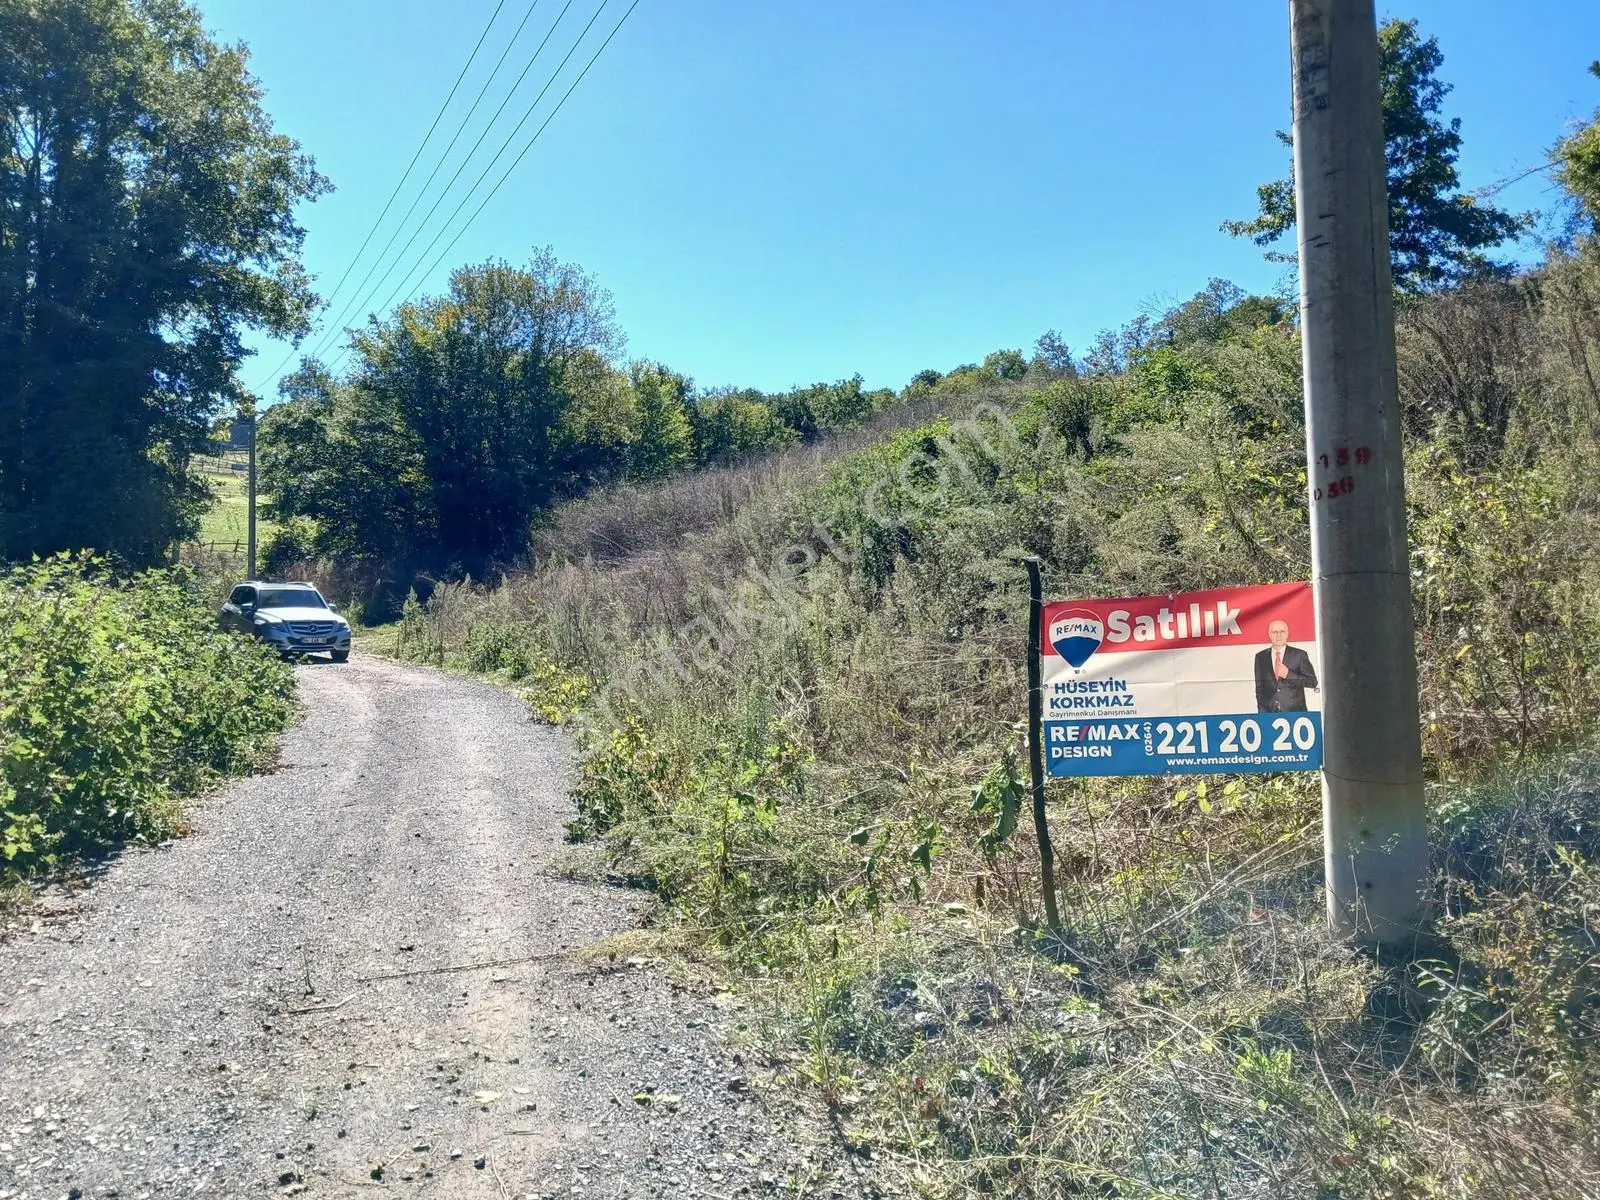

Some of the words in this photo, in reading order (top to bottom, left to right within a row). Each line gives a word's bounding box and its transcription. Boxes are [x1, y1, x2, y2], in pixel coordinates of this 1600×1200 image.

[1056, 623, 1097, 636] RE/MAX
[1106, 601, 1243, 643] Satılık
[1054, 677, 1127, 695] HÜSEYİN
[1050, 694, 1135, 709] KORKMAZ
[1049, 709, 1096, 718] Gayrimenkul
[1097, 709, 1138, 717] Danışmanı
[1050, 724, 1141, 743] RE/MAX
[1144, 721, 1153, 757] (0264)
[1156, 721, 1209, 755] 221
[1218, 719, 1262, 753] 20
[1272, 716, 1316, 751] 20
[1051, 745, 1113, 759] DESIGN
[1166, 753, 1309, 766] www.remaxdesign.com.tr
